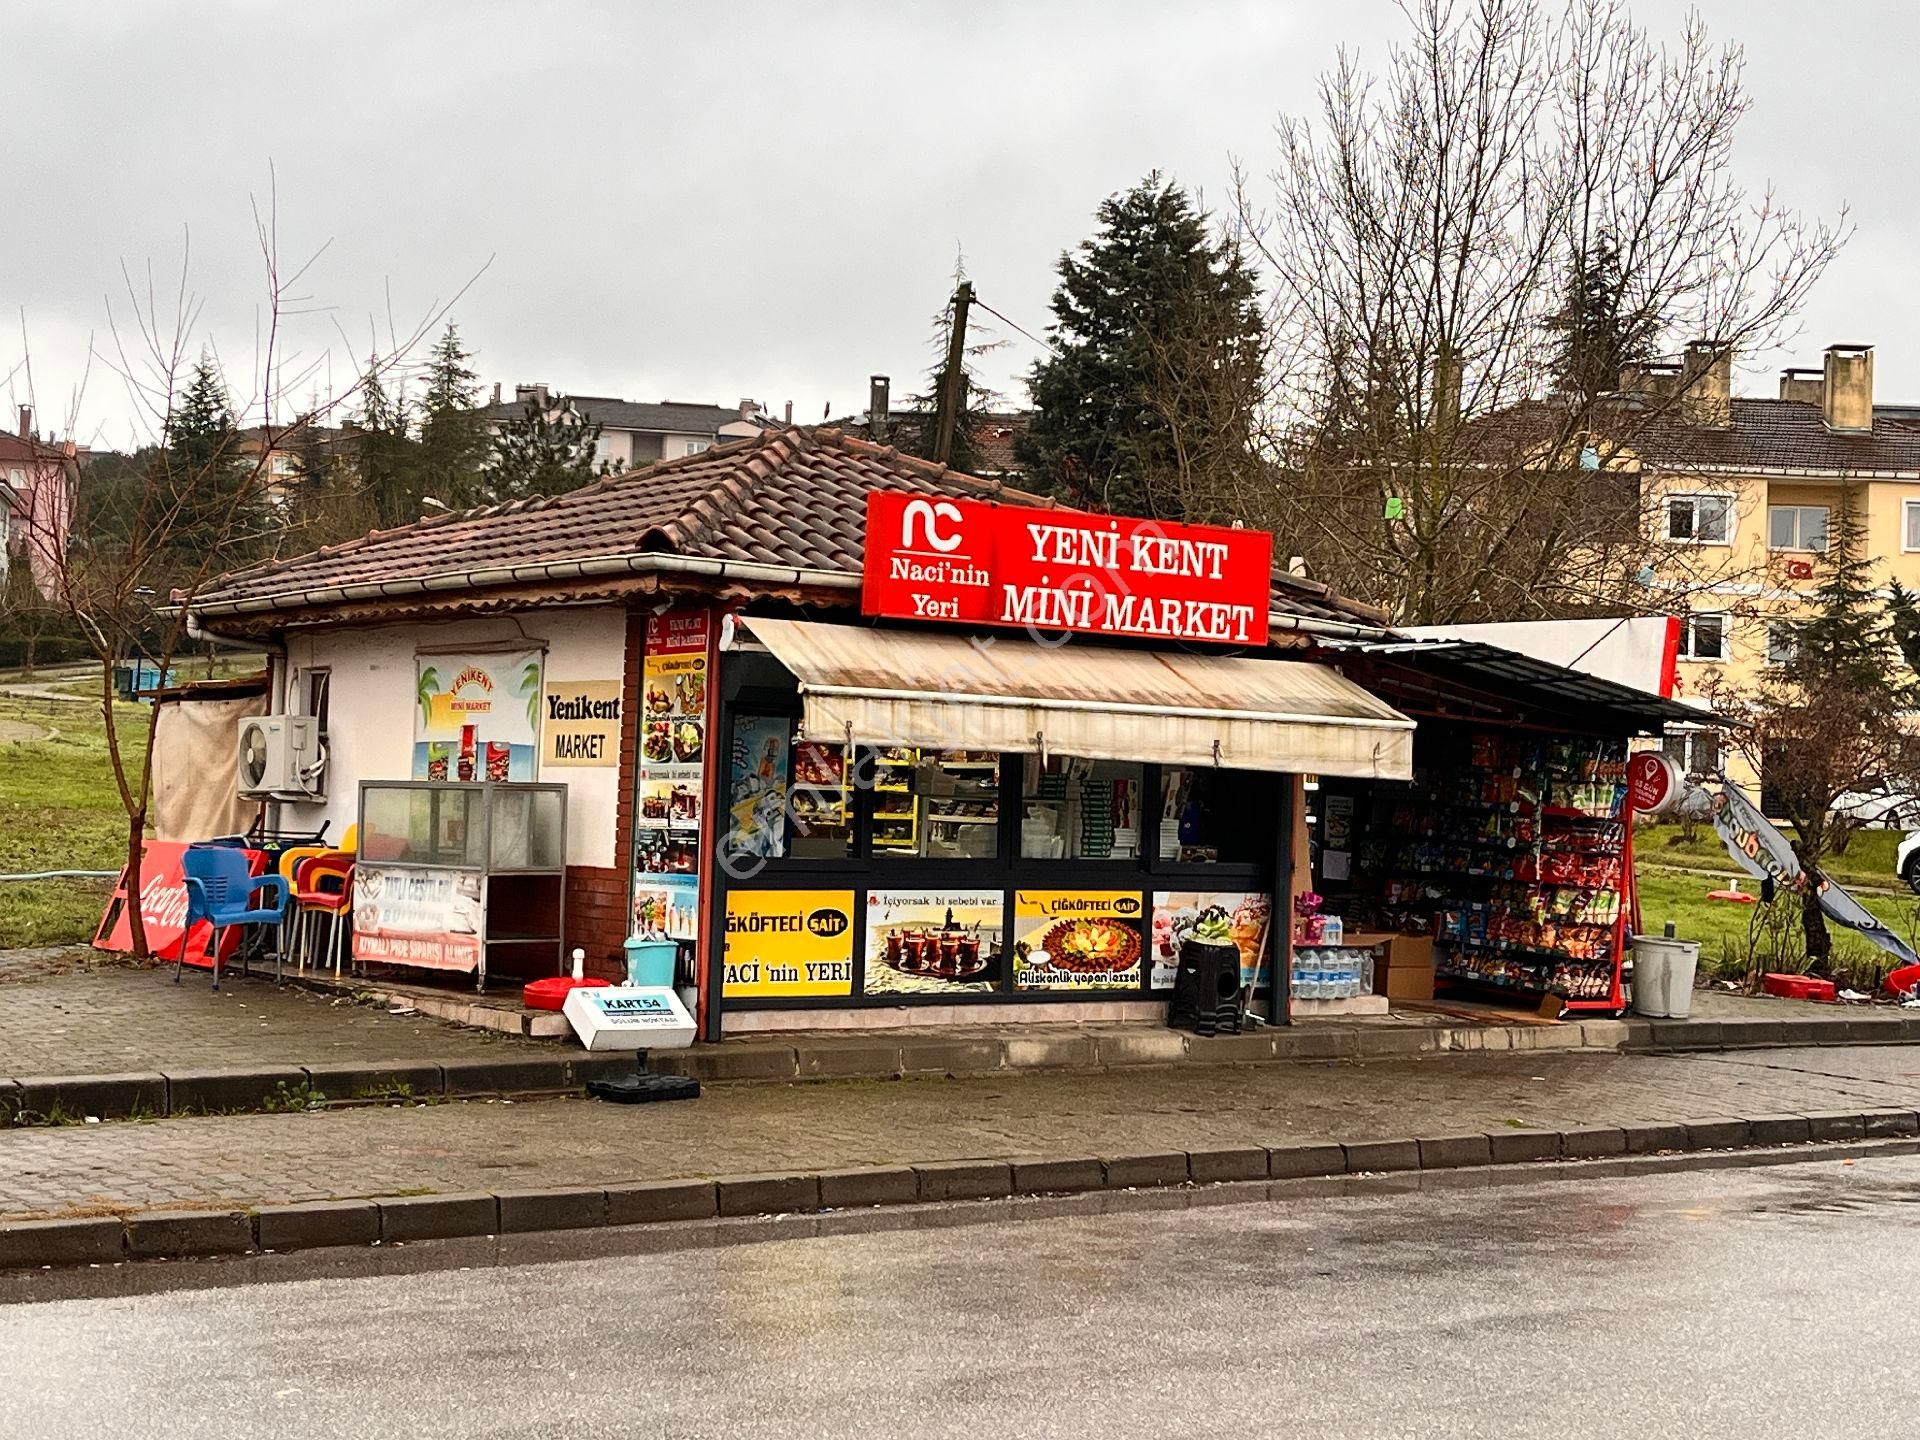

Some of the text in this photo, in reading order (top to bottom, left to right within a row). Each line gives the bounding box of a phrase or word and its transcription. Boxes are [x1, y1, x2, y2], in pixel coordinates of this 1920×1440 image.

[1027, 521, 1229, 580] YENİ KENT
[911, 594, 959, 618] Yeri
[1001, 575, 1254, 641] MİNİ MARKET
[465, 701, 492, 711] MARKET
[547, 694, 620, 720] Yenikent
[555, 734, 606, 758] MARKET
[1051, 898, 1111, 914] ÇİĞKÖFTECİ
[724, 958, 760, 983] ACİ
[805, 956, 851, 981] YERİ
